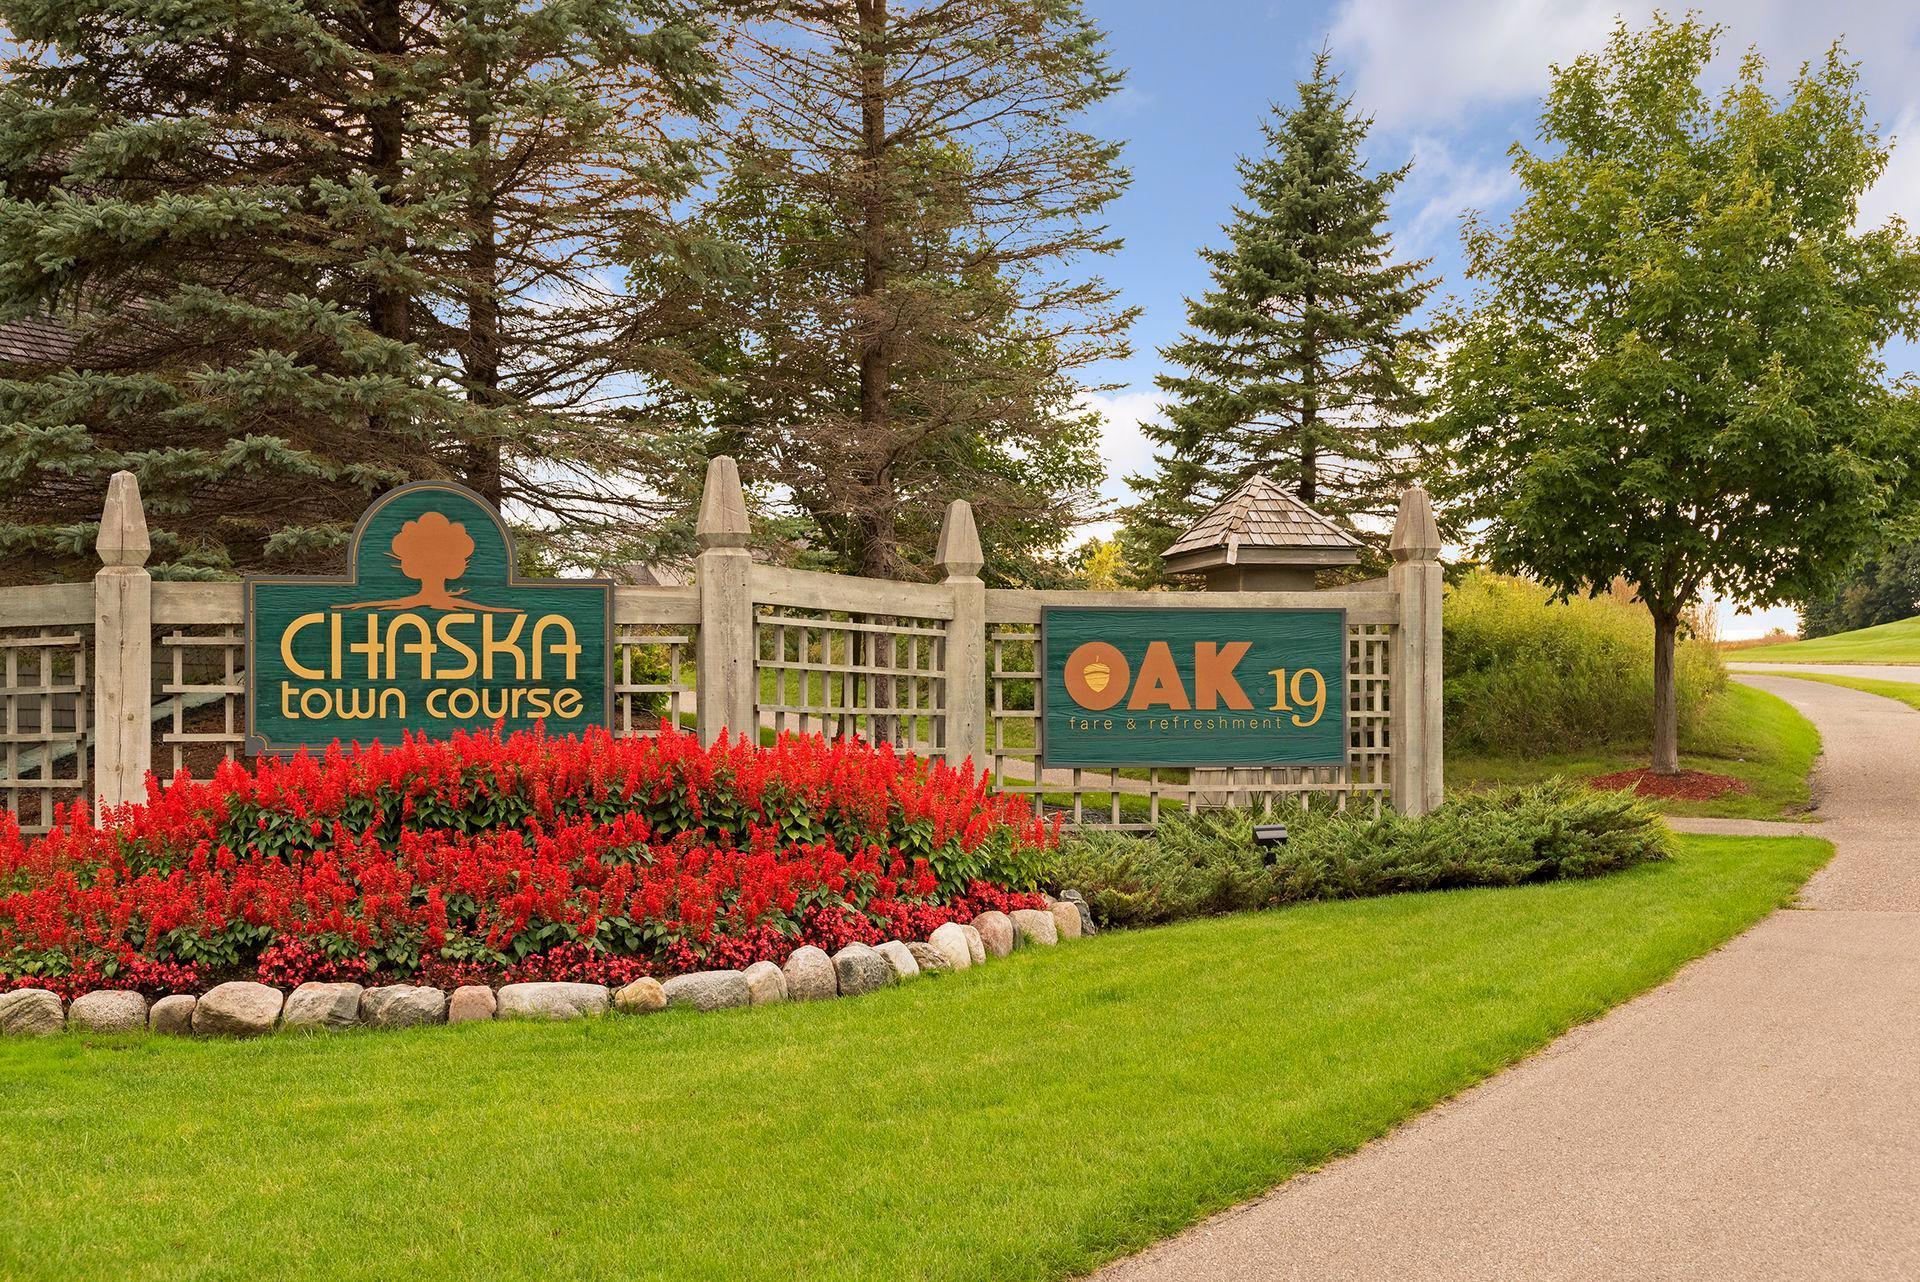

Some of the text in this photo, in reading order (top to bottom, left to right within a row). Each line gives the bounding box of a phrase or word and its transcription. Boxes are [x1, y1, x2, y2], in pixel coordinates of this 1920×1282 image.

[280, 612, 582, 680] CHASKA
[281, 681, 584, 719] town course
[1063, 641, 1327, 728] OAK 19
[1069, 715, 1282, 730] fare & refreshment
